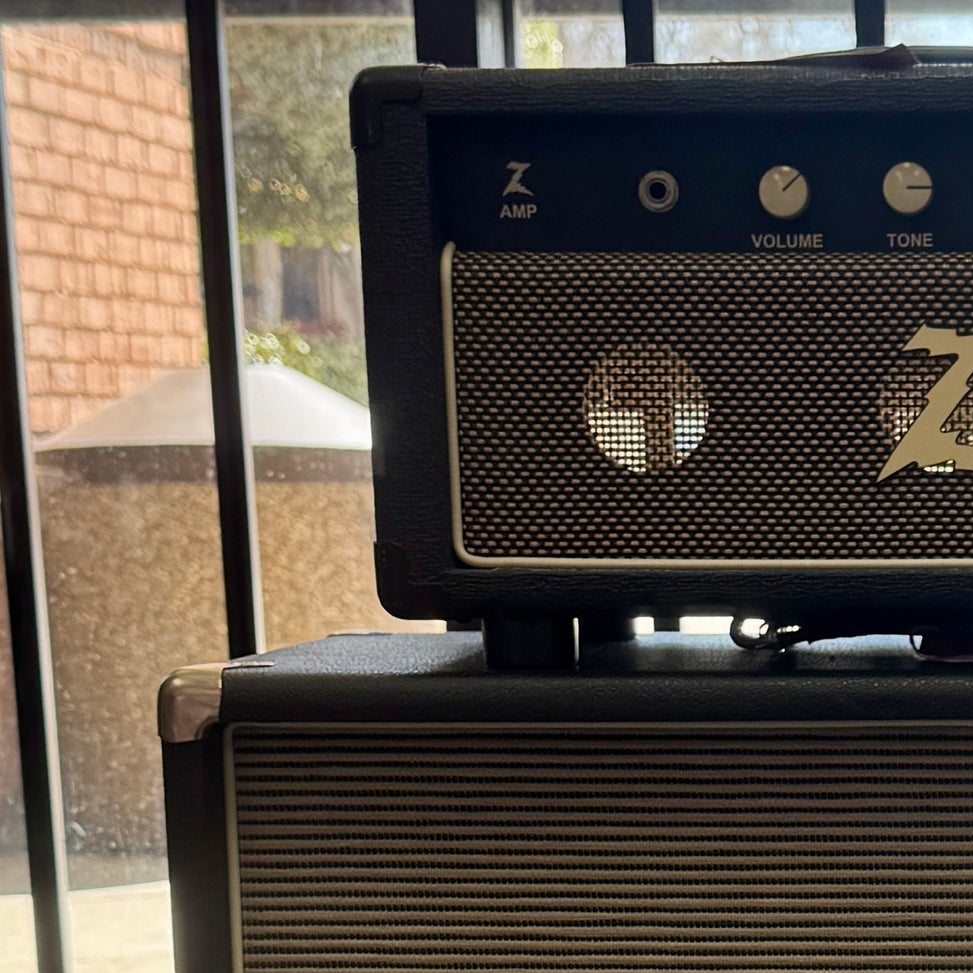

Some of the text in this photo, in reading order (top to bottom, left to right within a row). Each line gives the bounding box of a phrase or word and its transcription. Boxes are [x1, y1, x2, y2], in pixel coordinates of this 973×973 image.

[502, 161, 534, 197] Z
[500, 204, 537, 219] AMP
[751, 233, 824, 248] VOLUME
[886, 232, 934, 248] TONE
